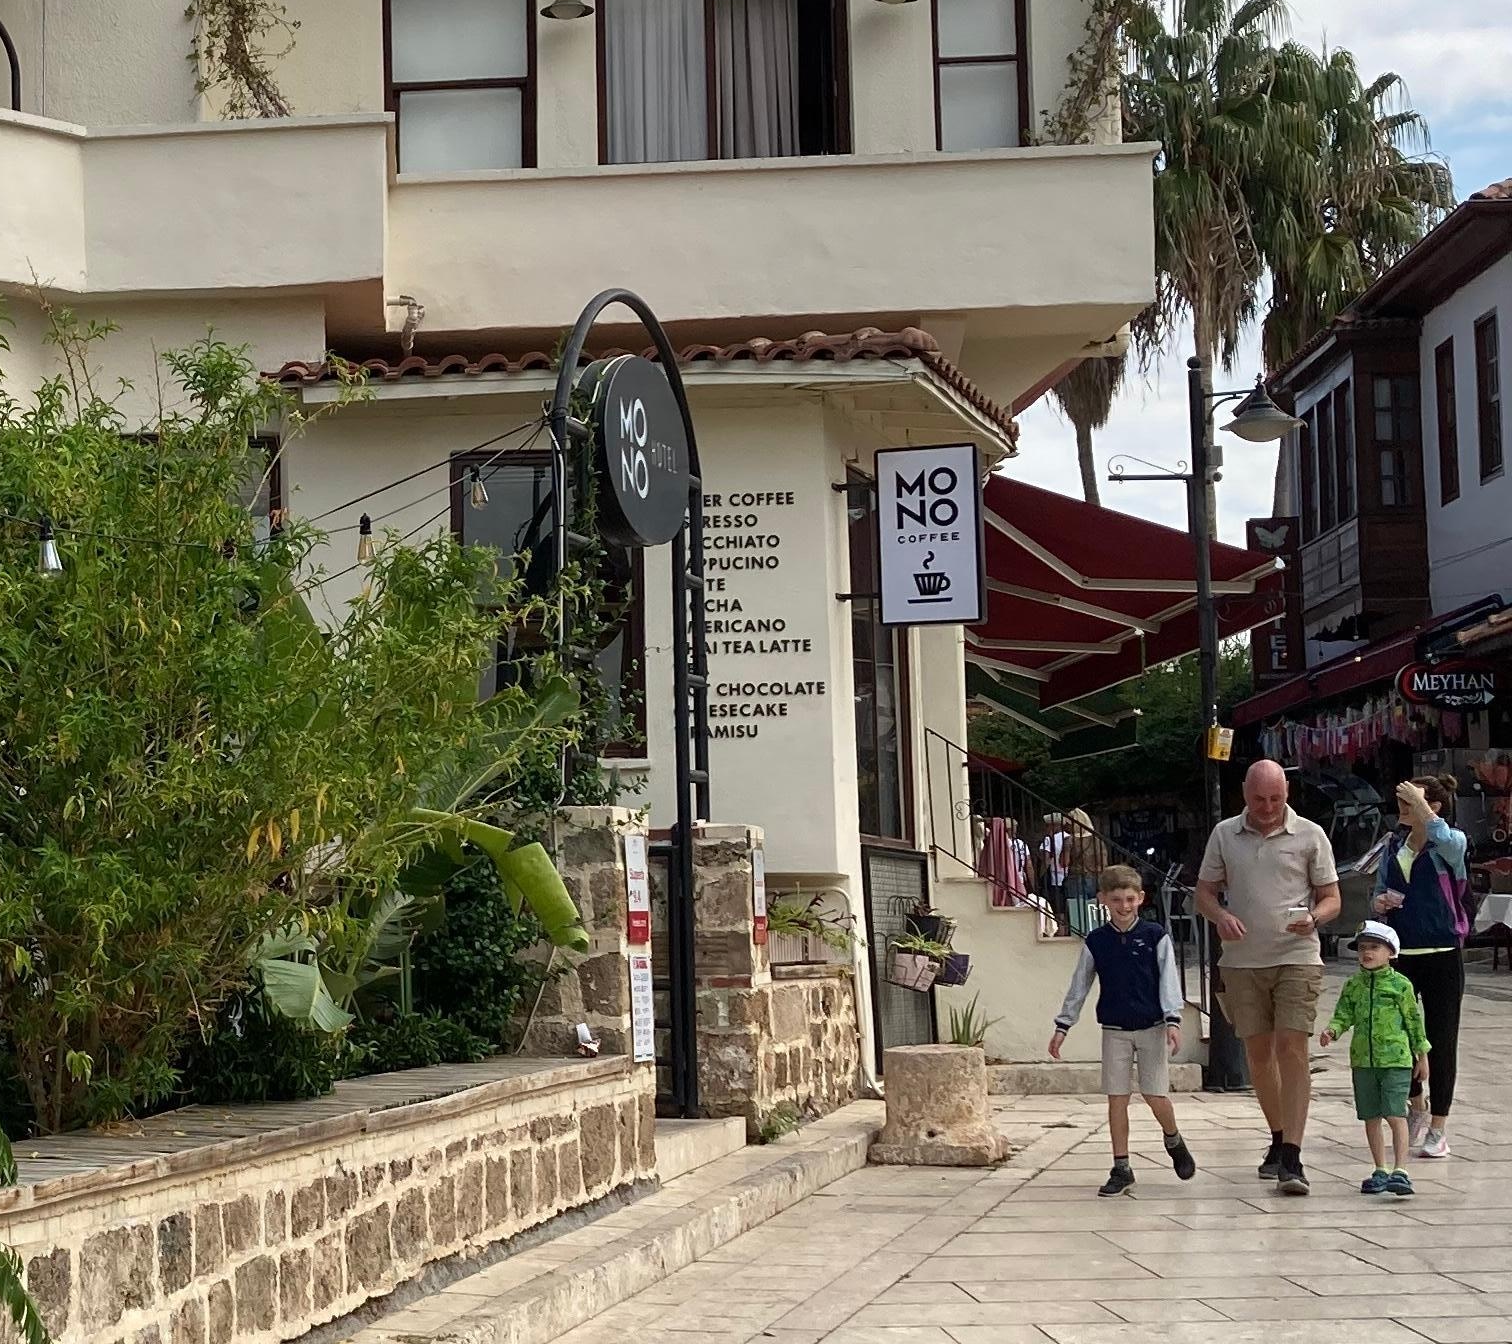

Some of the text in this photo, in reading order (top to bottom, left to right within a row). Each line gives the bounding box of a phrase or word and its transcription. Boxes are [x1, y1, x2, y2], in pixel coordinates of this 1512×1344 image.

[619, 397, 648, 447] MO
[650, 440, 678, 474] HOTEL
[621, 446, 649, 499] NO
[895, 467, 957, 498] MO
[729, 492, 794, 507] COFFEE
[896, 498, 958, 529] NO
[702, 514, 758, 529] RESSO
[702, 535, 780, 550] CCHIATO
[897, 532, 960, 544] COFFEE
[704, 599, 743, 613] CHA
[704, 618, 786, 633] ERICANO
[723, 640, 755, 654] TEA
[760, 639, 812, 653] LATTE
[717, 681, 826, 697] CHOCOLATE
[709, 702, 788, 718] ESECAKE
[705, 724, 759, 739] AMISU
